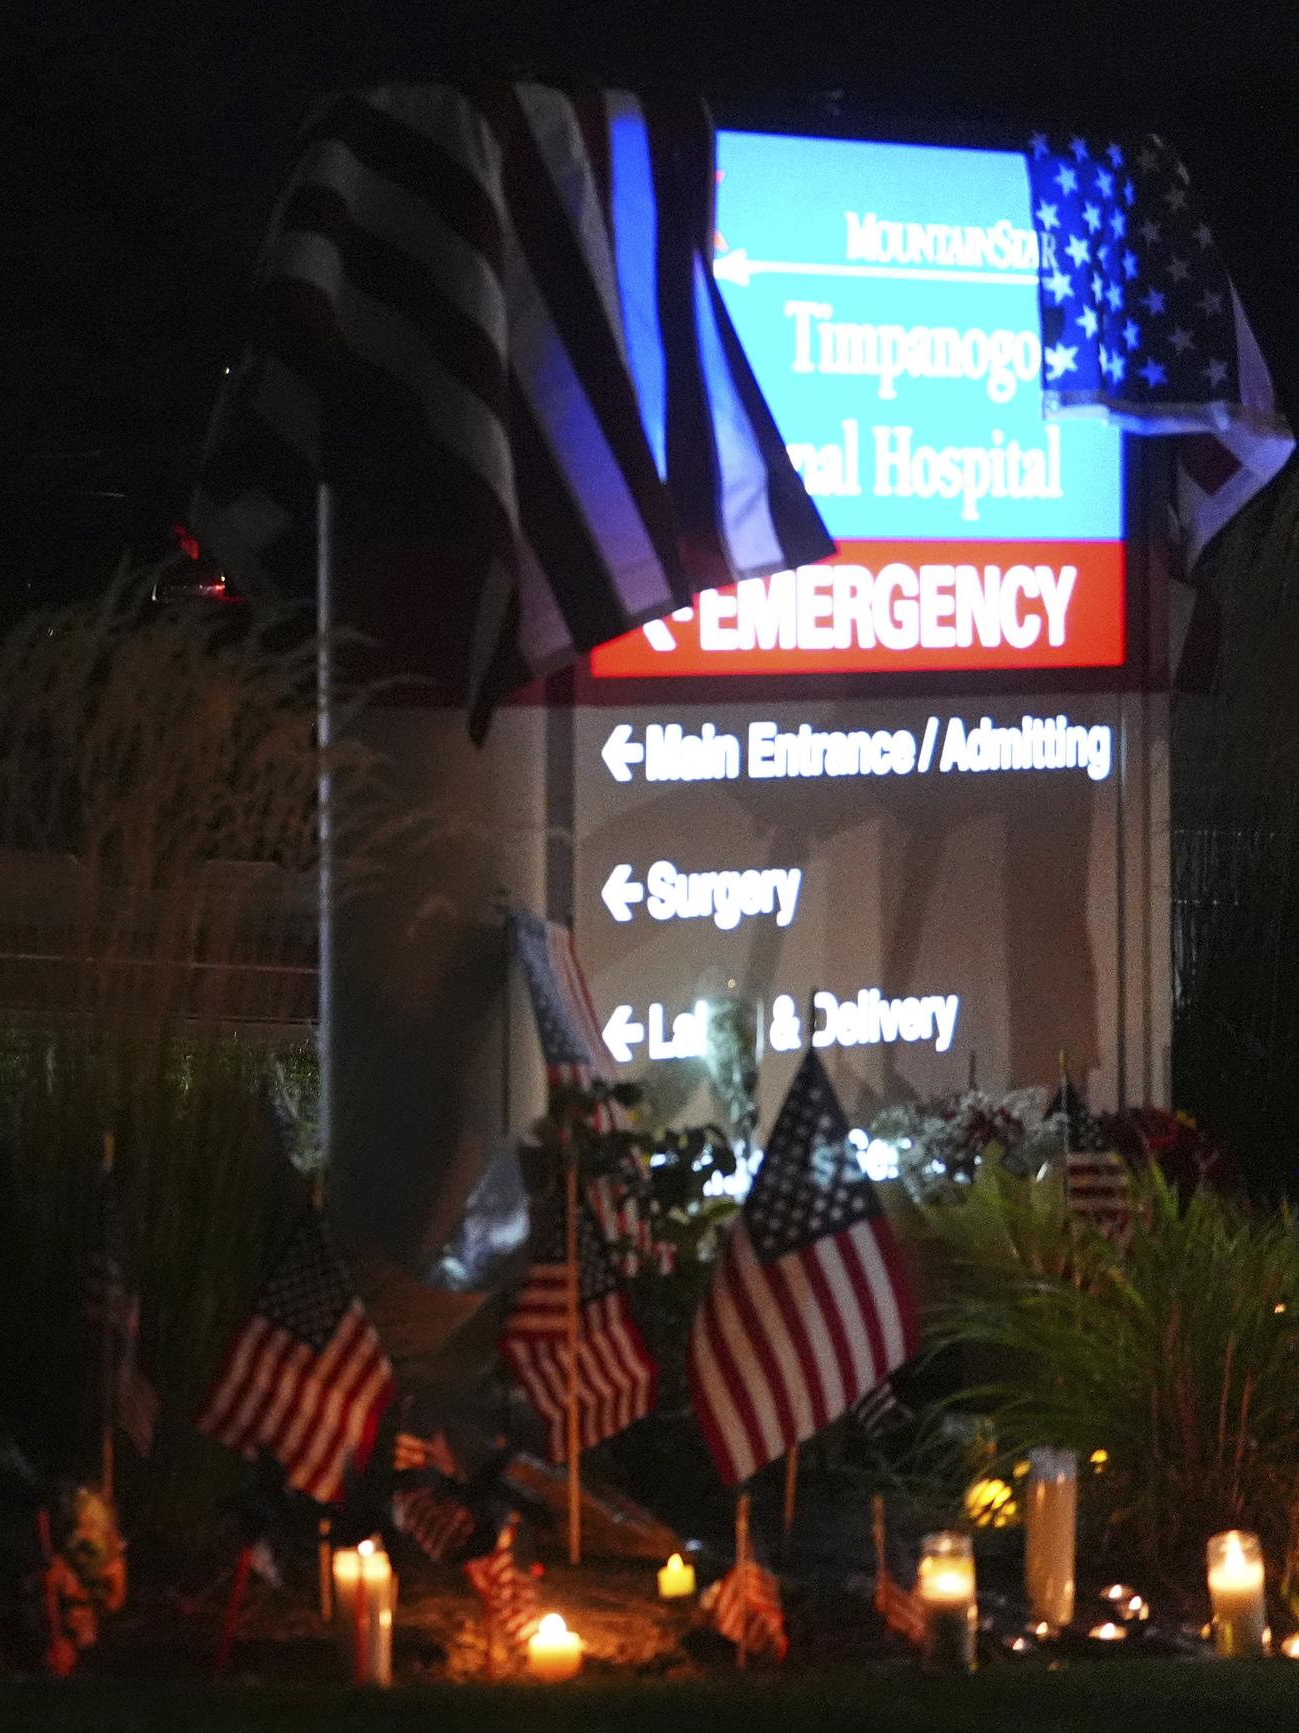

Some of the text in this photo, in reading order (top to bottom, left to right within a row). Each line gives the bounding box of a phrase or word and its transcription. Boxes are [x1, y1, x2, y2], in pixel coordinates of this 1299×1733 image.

[783, 300, 1041, 403] Timpanogo
[871, 424, 1064, 521] Hospital
[700, 563, 1077, 651] EMERGENCY
[645, 722, 739, 781] Main
[747, 720, 916, 778] Entrance
[939, 714, 1111, 780] Admitting
[646, 861, 801, 930] Surgery
[769, 994, 801, 1051] &
[811, 988, 959, 1052] Delivery
